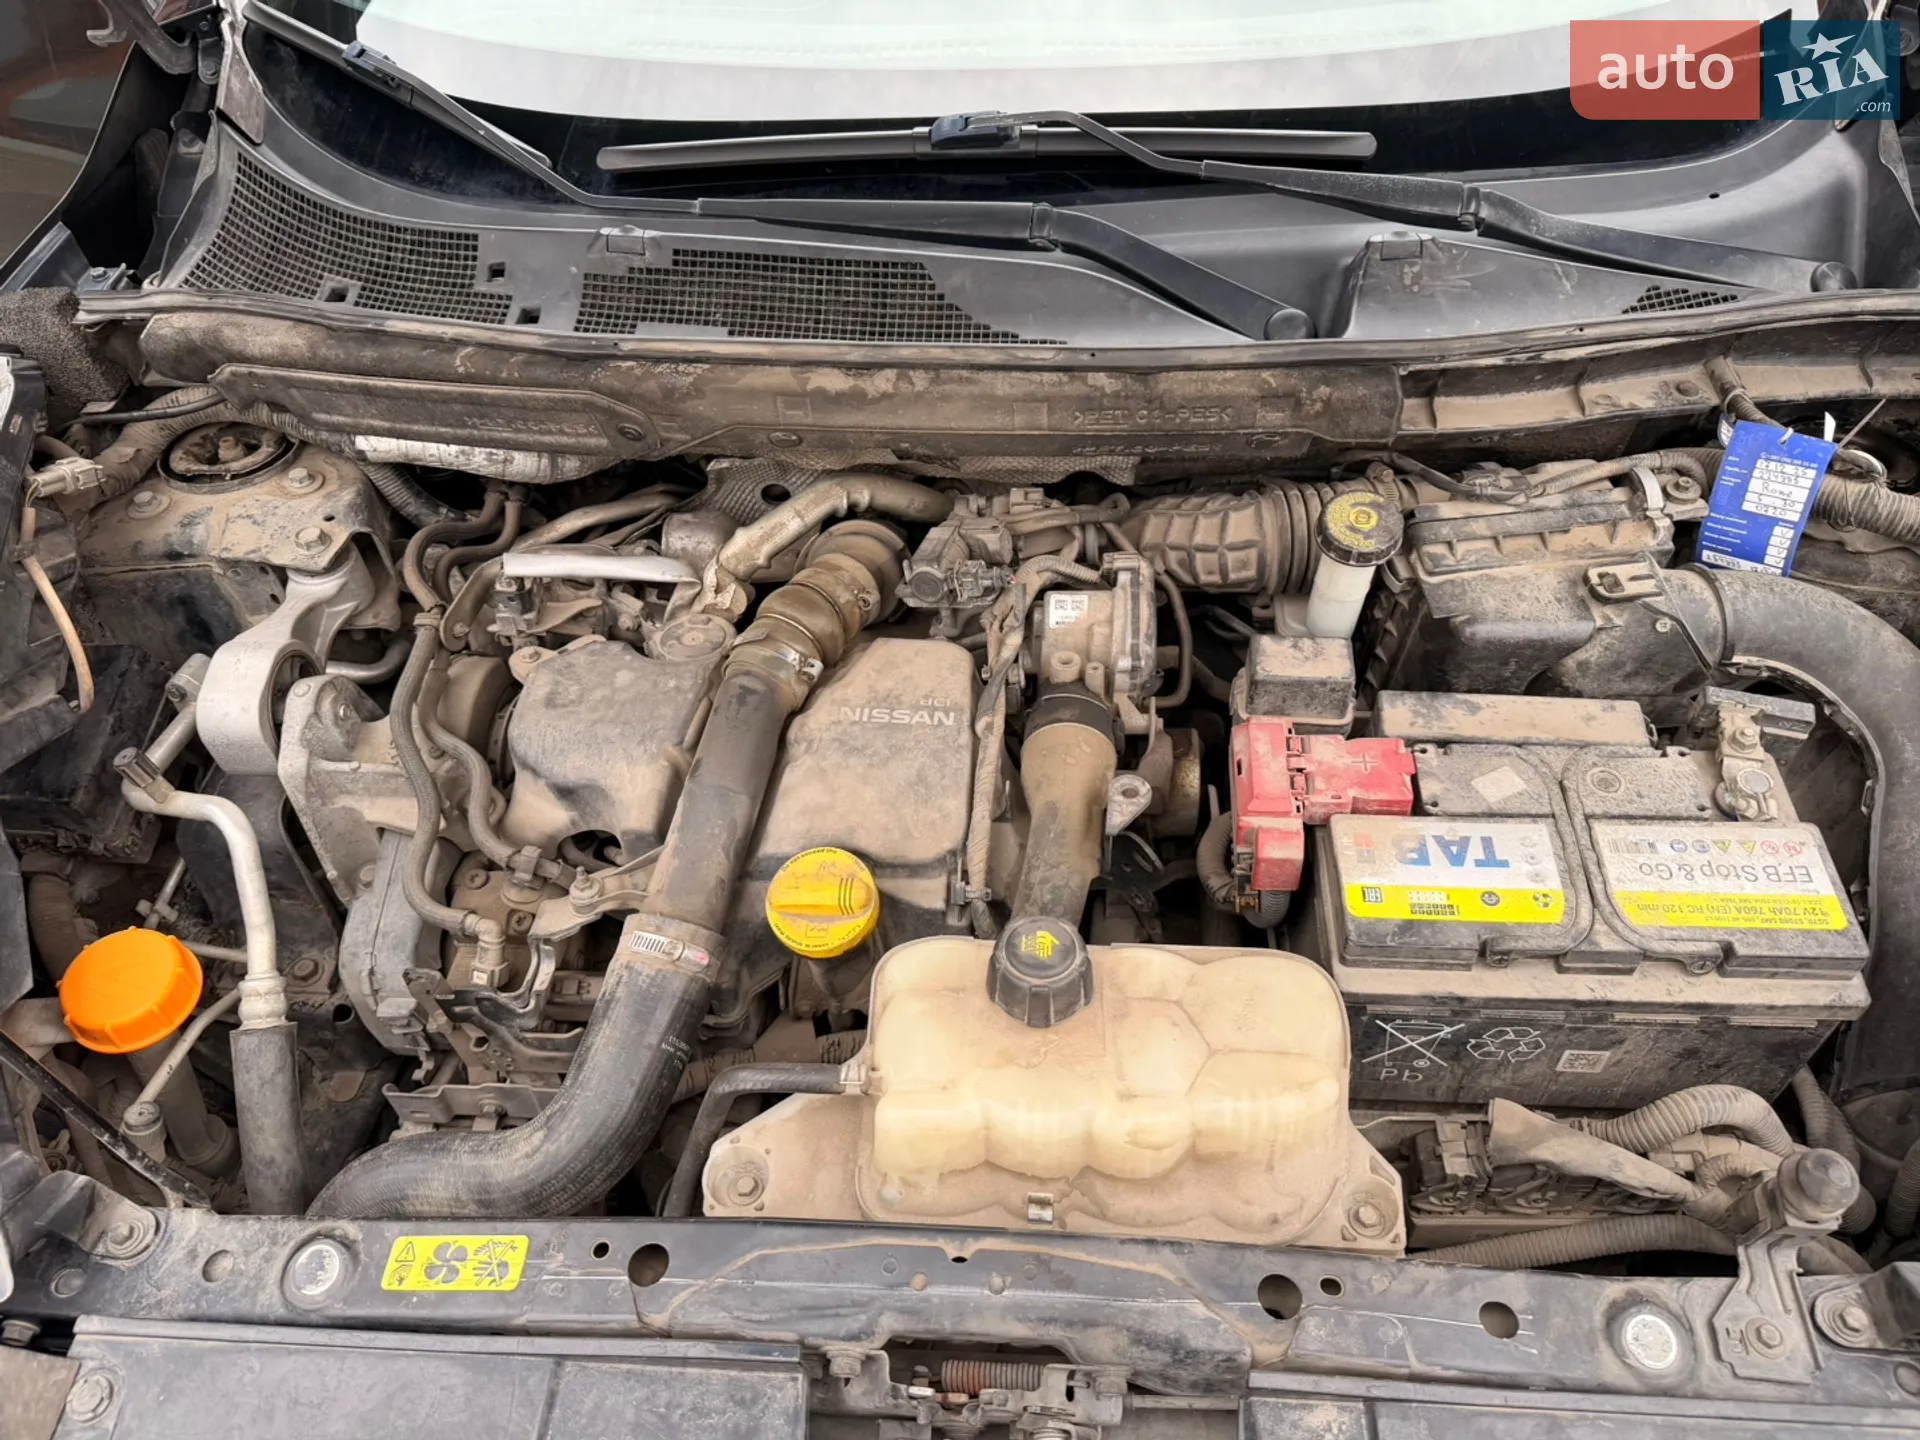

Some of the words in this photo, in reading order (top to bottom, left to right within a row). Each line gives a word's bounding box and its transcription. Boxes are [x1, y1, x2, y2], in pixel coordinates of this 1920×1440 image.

[839, 707, 955, 726] NISSAN
[1391, 834, 1510, 869] TAB
[1638, 862, 1673, 881] Go
[1677, 863, 1694, 881] &
[1700, 860, 1760, 882] Stop
[1762, 865, 1813, 883] EFB
[1662, 903, 1684, 913] 120
[1686, 904, 1703, 914] RC
[1706, 903, 1732, 915] (EN)
[1733, 904, 1765, 915] 760A
[1767, 905, 1800, 916] 70Ah
[1380, 1068, 1423, 1083] Pb
